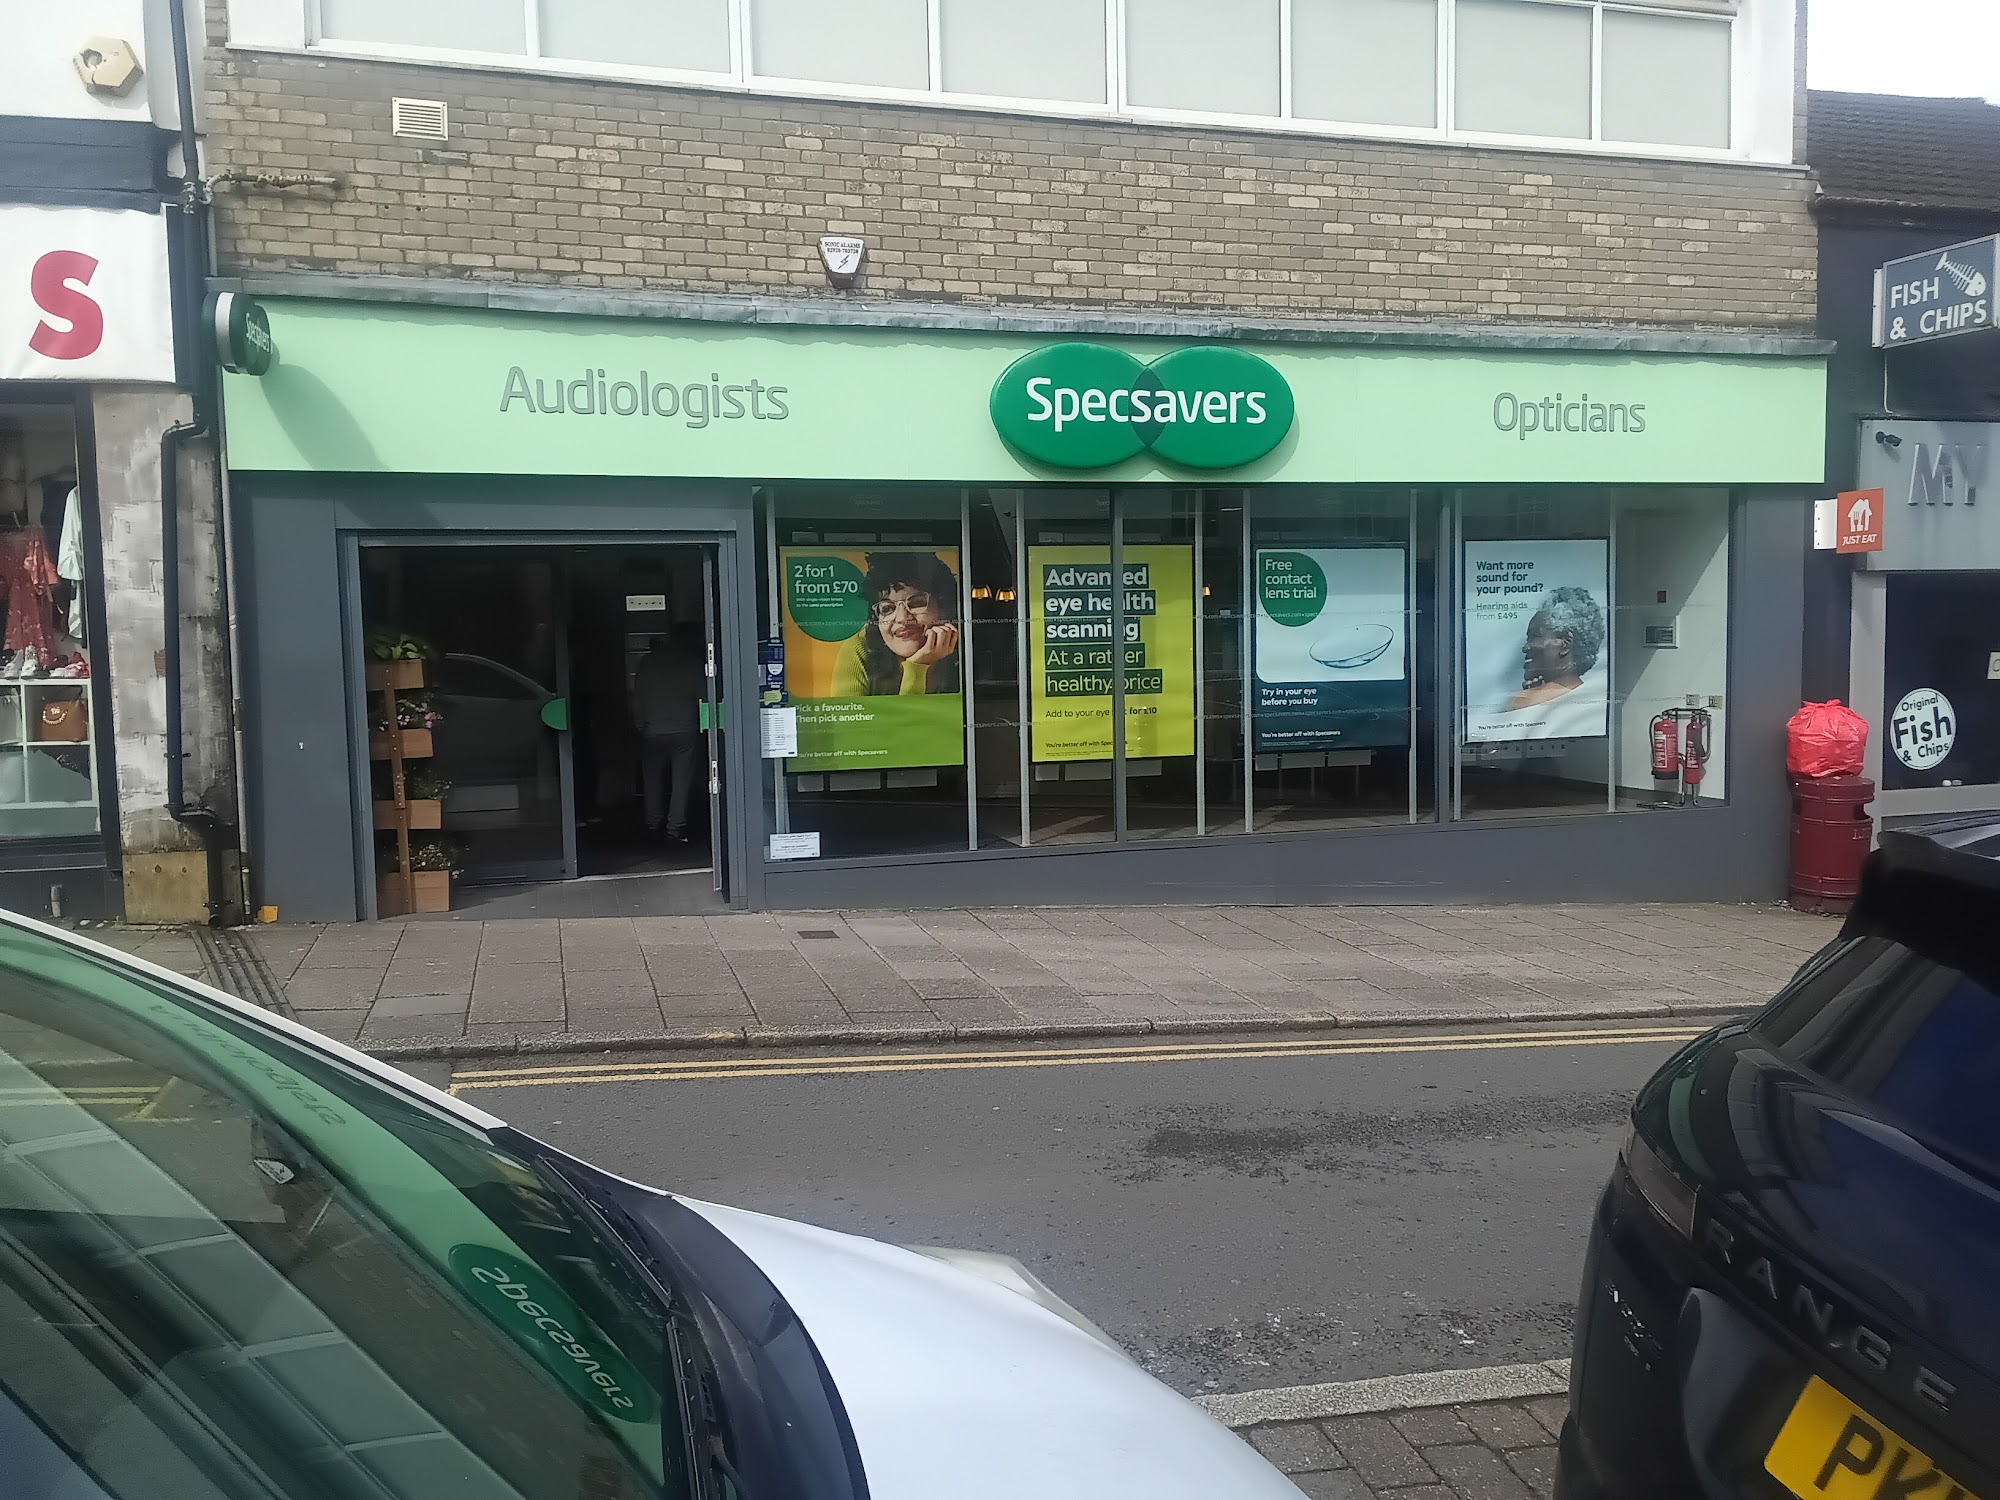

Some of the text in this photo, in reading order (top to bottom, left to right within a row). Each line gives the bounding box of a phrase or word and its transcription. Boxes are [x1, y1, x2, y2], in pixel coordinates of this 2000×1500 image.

[1890, 277, 1939, 308] FISH
[28, 250, 104, 360] S
[1889, 299, 1987, 340] & CHIPS
[499, 365, 790, 428] Audiologists
[1026, 376, 1267, 432] Specsavers
[1493, 391, 1646, 441] Opticians
[1842, 533, 1878, 546] JUST EAT
[794, 564, 834, 578] 2 for 1
[1265, 559, 1293, 571] Free
[1476, 561, 1534, 571] Want more
[1045, 567, 1147, 586] Advaned
[1265, 573, 1312, 585] contact
[1476, 571, 1528, 583] sound for
[794, 581, 859, 594] from £70
[1265, 586, 1317, 599] lens trial
[1476, 583, 1544, 596] your pound?
[1045, 596, 1083, 616] eye
[1476, 603, 1509, 612] Hearing
[1510, 601, 1528, 610] aids
[1476, 612, 1518, 621] from £495
[1046, 618, 1139, 641] scannig
[1047, 649, 1143, 666] At a rater
[1261, 688, 1317, 697] Try in your eye
[821, 703, 865, 712] favourite.
[1261, 697, 1318, 707] before you buy
[1901, 693, 1939, 711] Original
[818, 714, 837, 723] pick
[838, 713, 875, 722] another
[1045, 709, 1061, 718] Add
[1064, 709, 1073, 717] to
[1075, 709, 1094, 718] your
[1095, 709, 1110, 717] eye
[1129, 707, 1141, 715] for
[1893, 706, 1952, 749] Fish
[1902, 742, 1950, 762] & Chips
[1705, 1218, 1957, 1416] RANGE
[1813, 1414, 1982, 1500] PK
